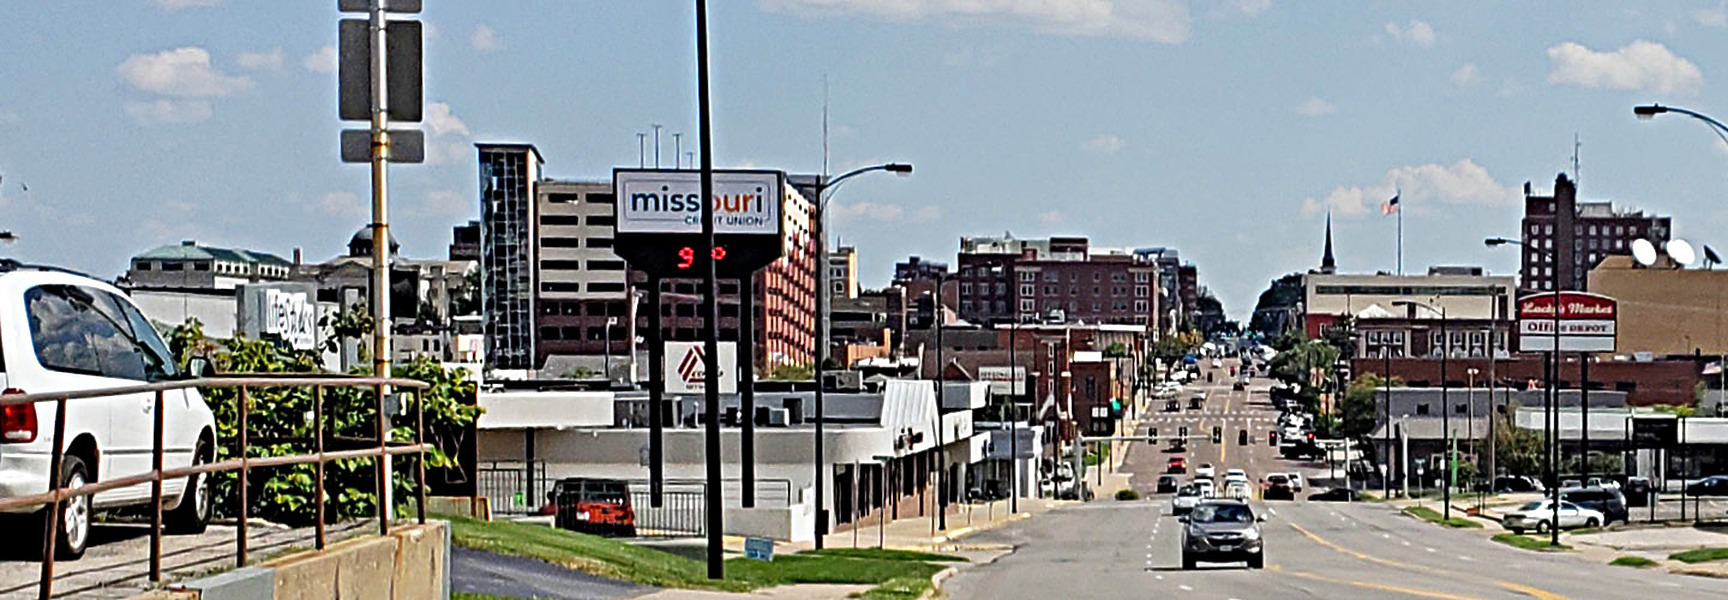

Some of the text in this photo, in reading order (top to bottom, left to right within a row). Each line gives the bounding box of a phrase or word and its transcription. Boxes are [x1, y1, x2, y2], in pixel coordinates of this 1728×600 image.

[684, 215, 763, 226] CRIT UNION
[1567, 302, 1612, 315] Market
[1527, 322, 1608, 333] Offie DEPOT
